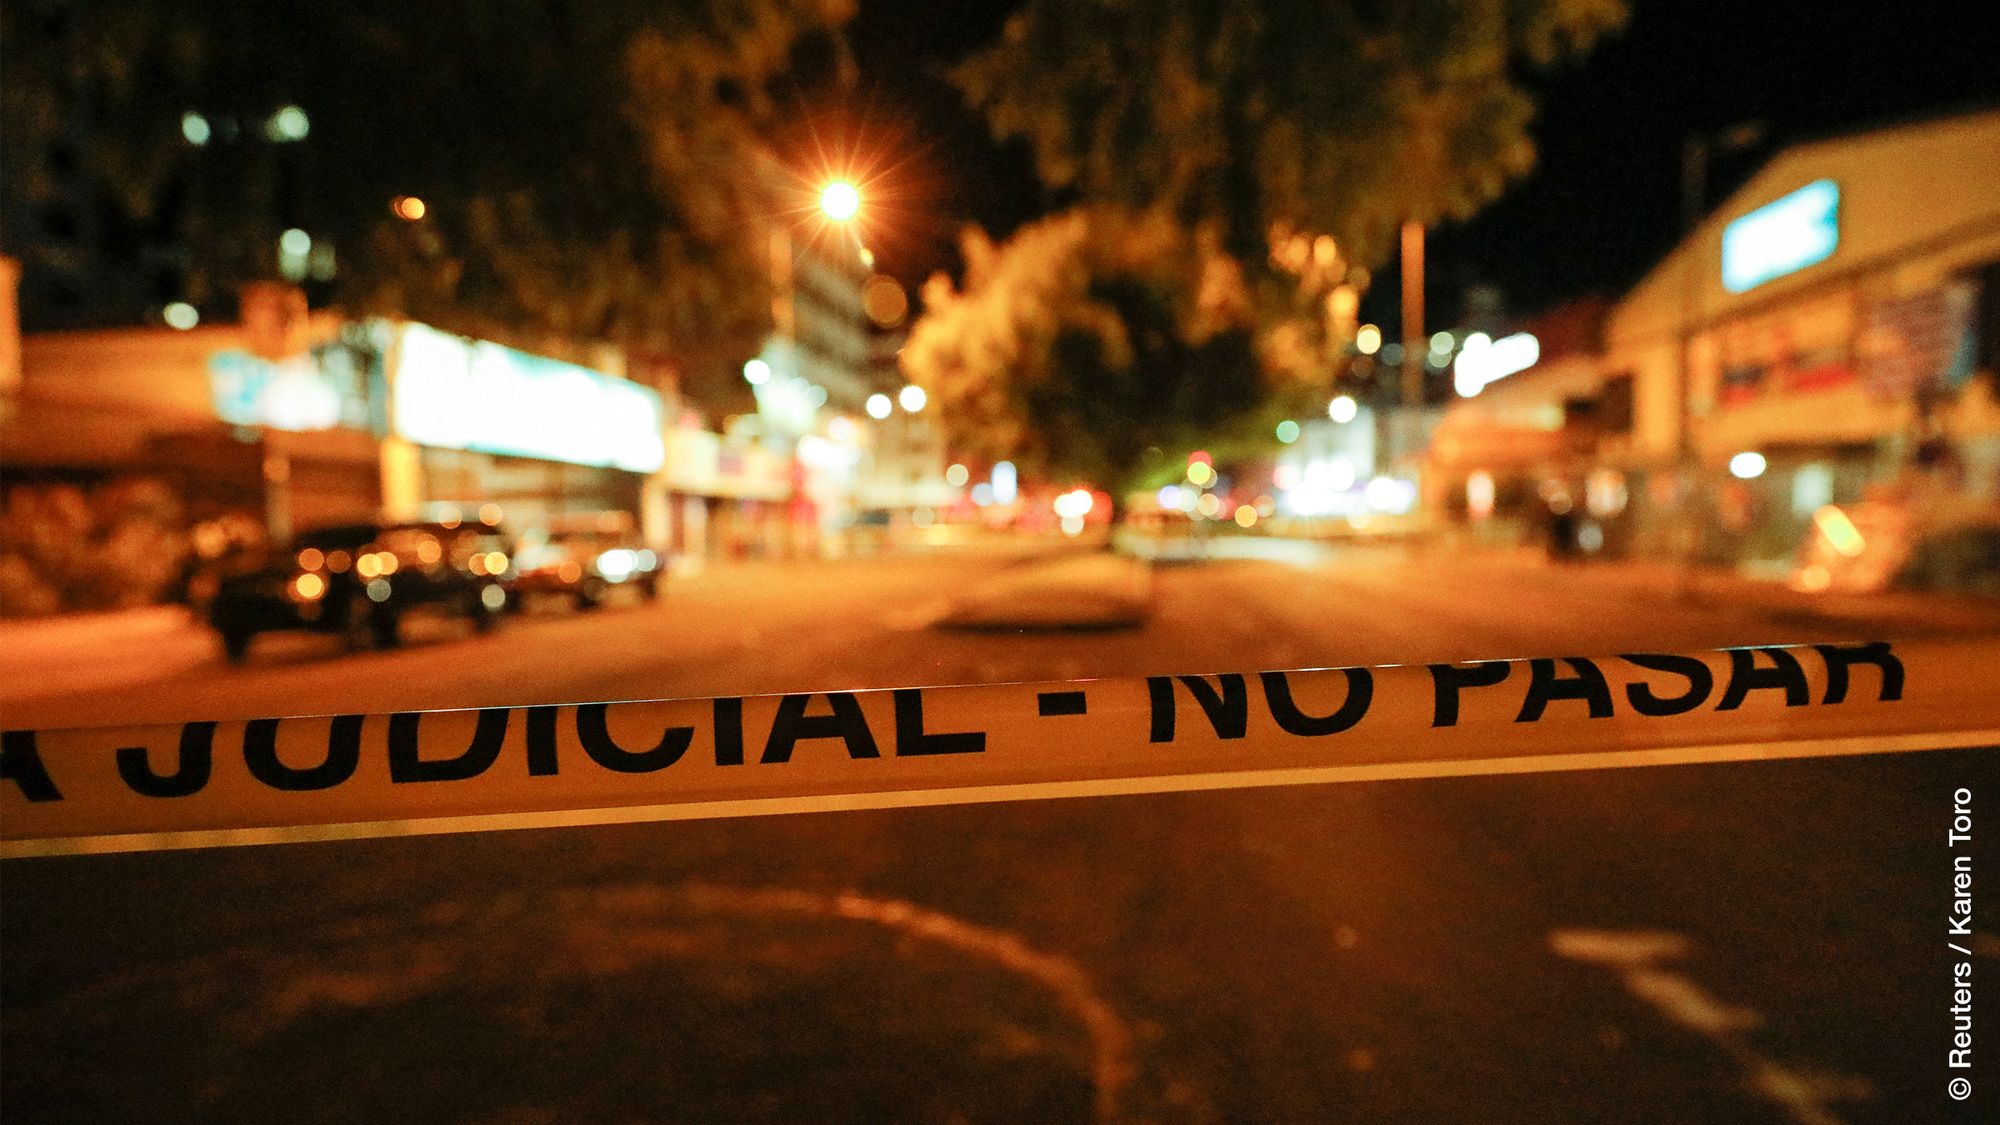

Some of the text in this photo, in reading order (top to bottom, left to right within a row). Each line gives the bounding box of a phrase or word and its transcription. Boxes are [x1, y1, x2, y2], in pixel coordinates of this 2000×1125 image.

[116, 689, 986, 798] JUDICIAL
[1146, 667, 1373, 743] NO
[1427, 642, 1904, 728] PASAR
